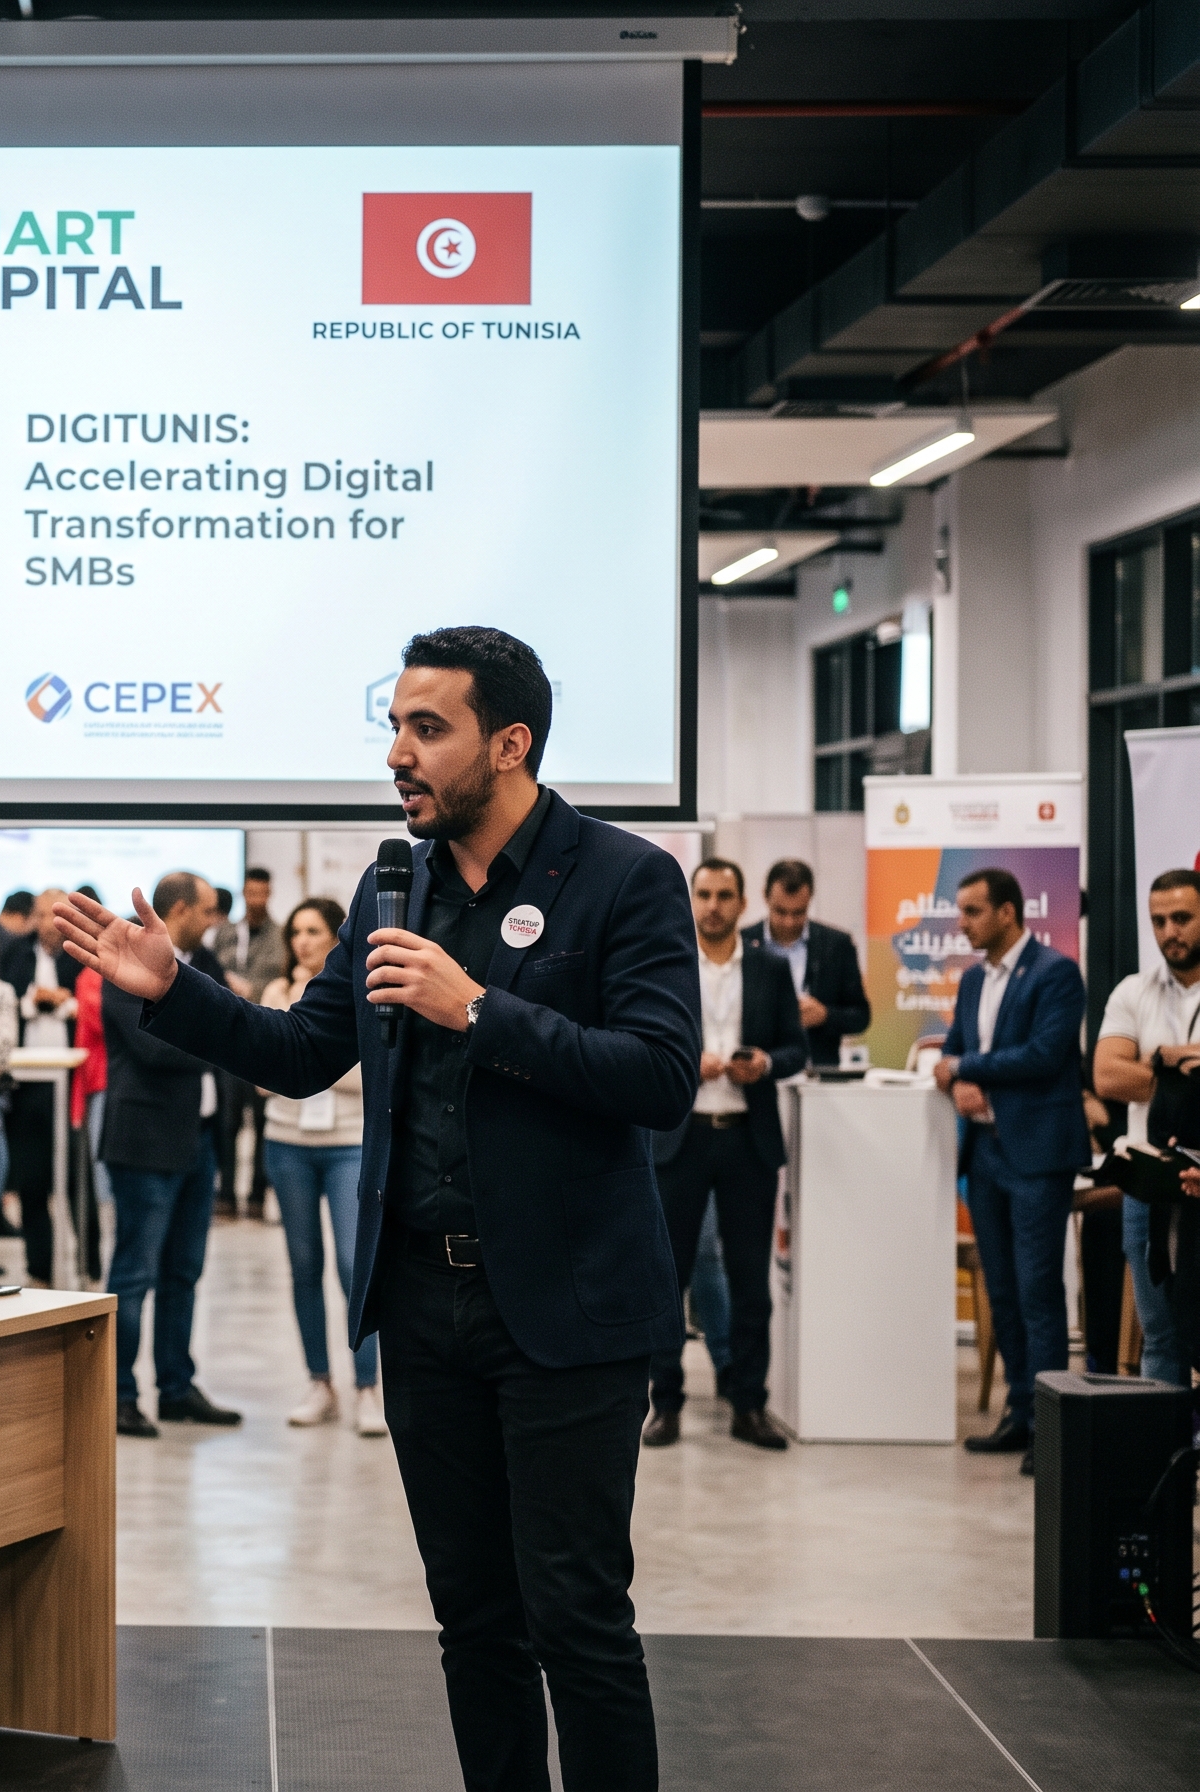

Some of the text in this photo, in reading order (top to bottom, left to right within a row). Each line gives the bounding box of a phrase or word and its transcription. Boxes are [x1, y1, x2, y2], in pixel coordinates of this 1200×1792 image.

[312, 321, 581, 340] REPUBLIC OF TUNISIA
[26, 413, 250, 444] DIGITUNIS:
[24, 459, 435, 499] Accelerating Digital
[24, 507, 405, 539] Transformation for
[24, 556, 135, 587] SMBs
[83, 682, 223, 714] CEPEX
